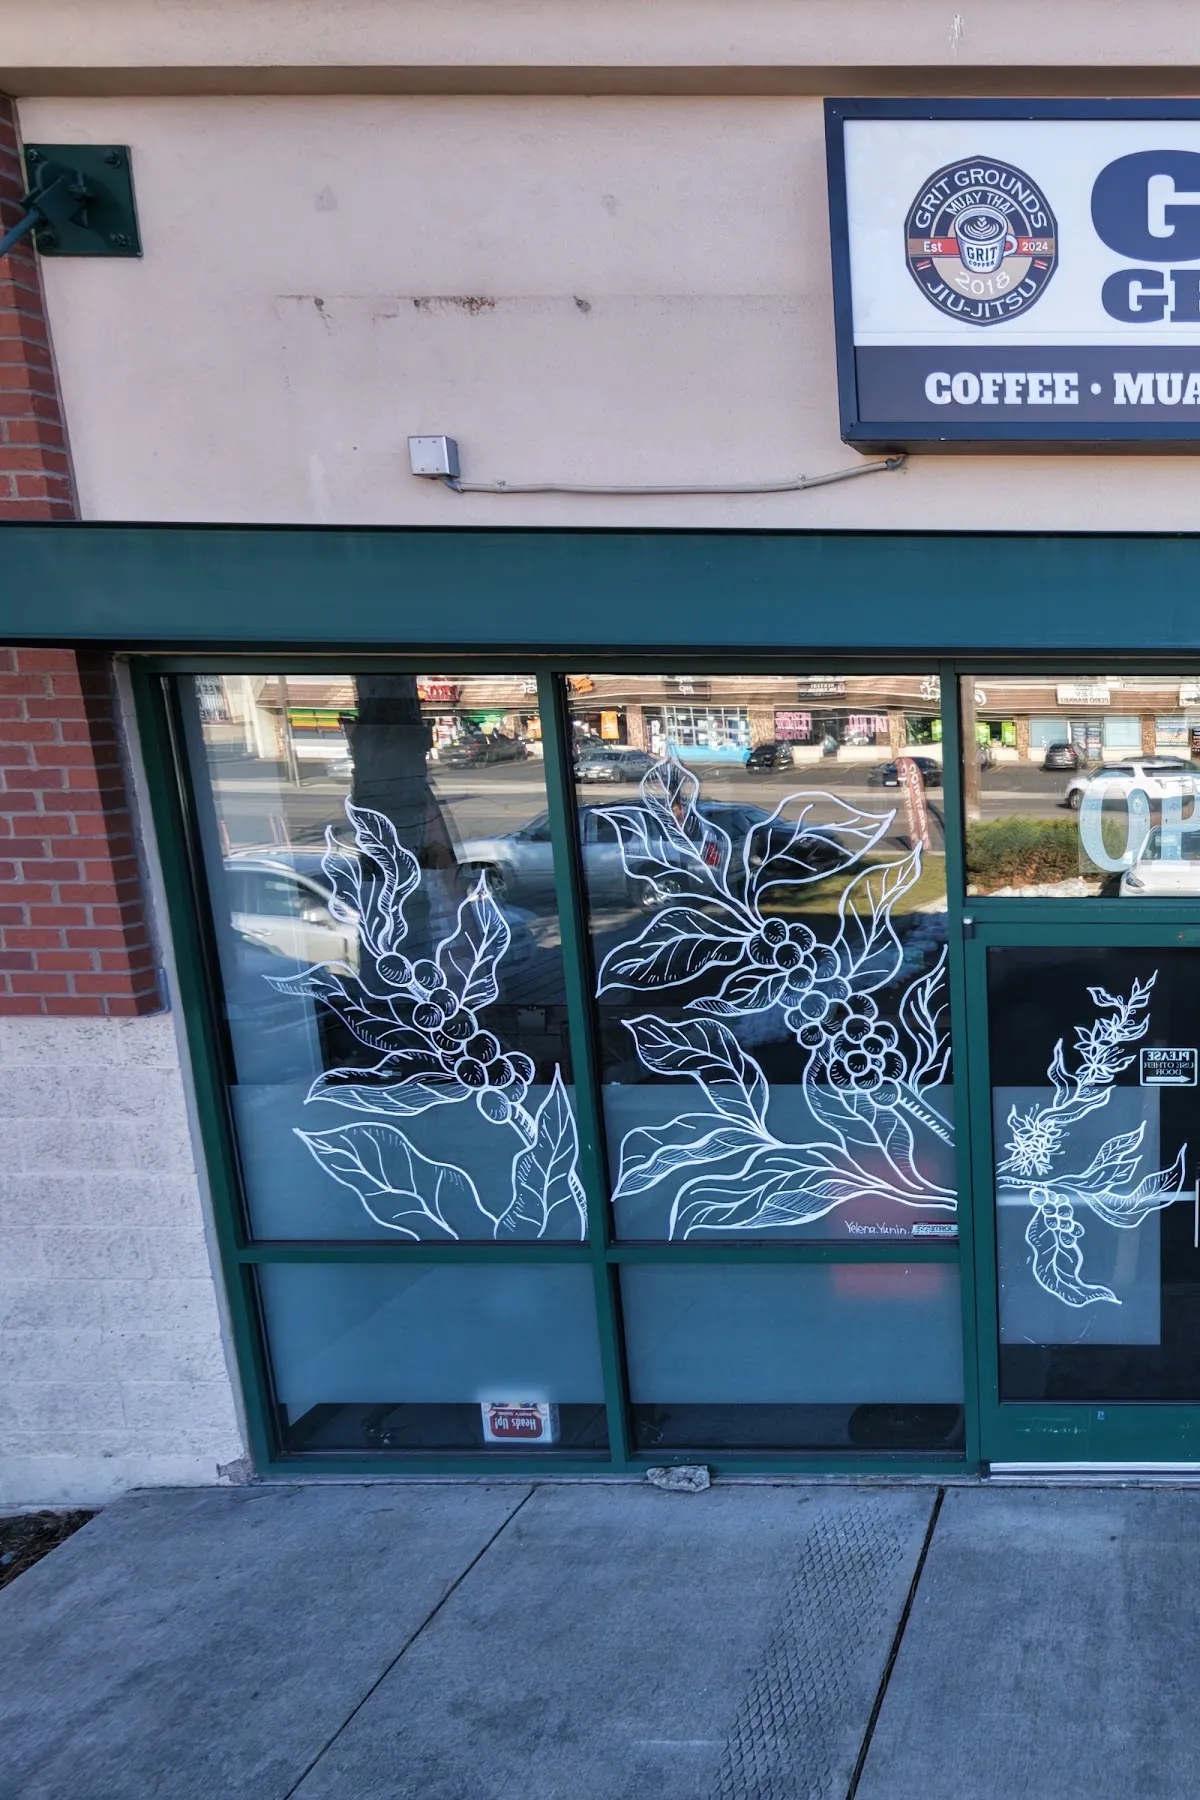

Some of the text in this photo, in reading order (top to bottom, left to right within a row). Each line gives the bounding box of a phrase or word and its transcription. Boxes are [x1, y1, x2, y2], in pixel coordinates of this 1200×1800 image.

[915, 168, 1047, 229] GRIT GROUNDS
[945, 192, 1015, 215] MUAY THAI
[923, 241, 943, 253] Est
[966, 246, 998, 262] GRIT
[1022, 241, 1049, 252] 2024
[968, 260, 995, 268] COFFEE
[954, 271, 1011, 295] 2018
[927, 277, 1037, 318] JIU-JITSU
[925, 371, 1080, 407] COFFEE
[495, 1416, 536, 1430] Heads Up!
